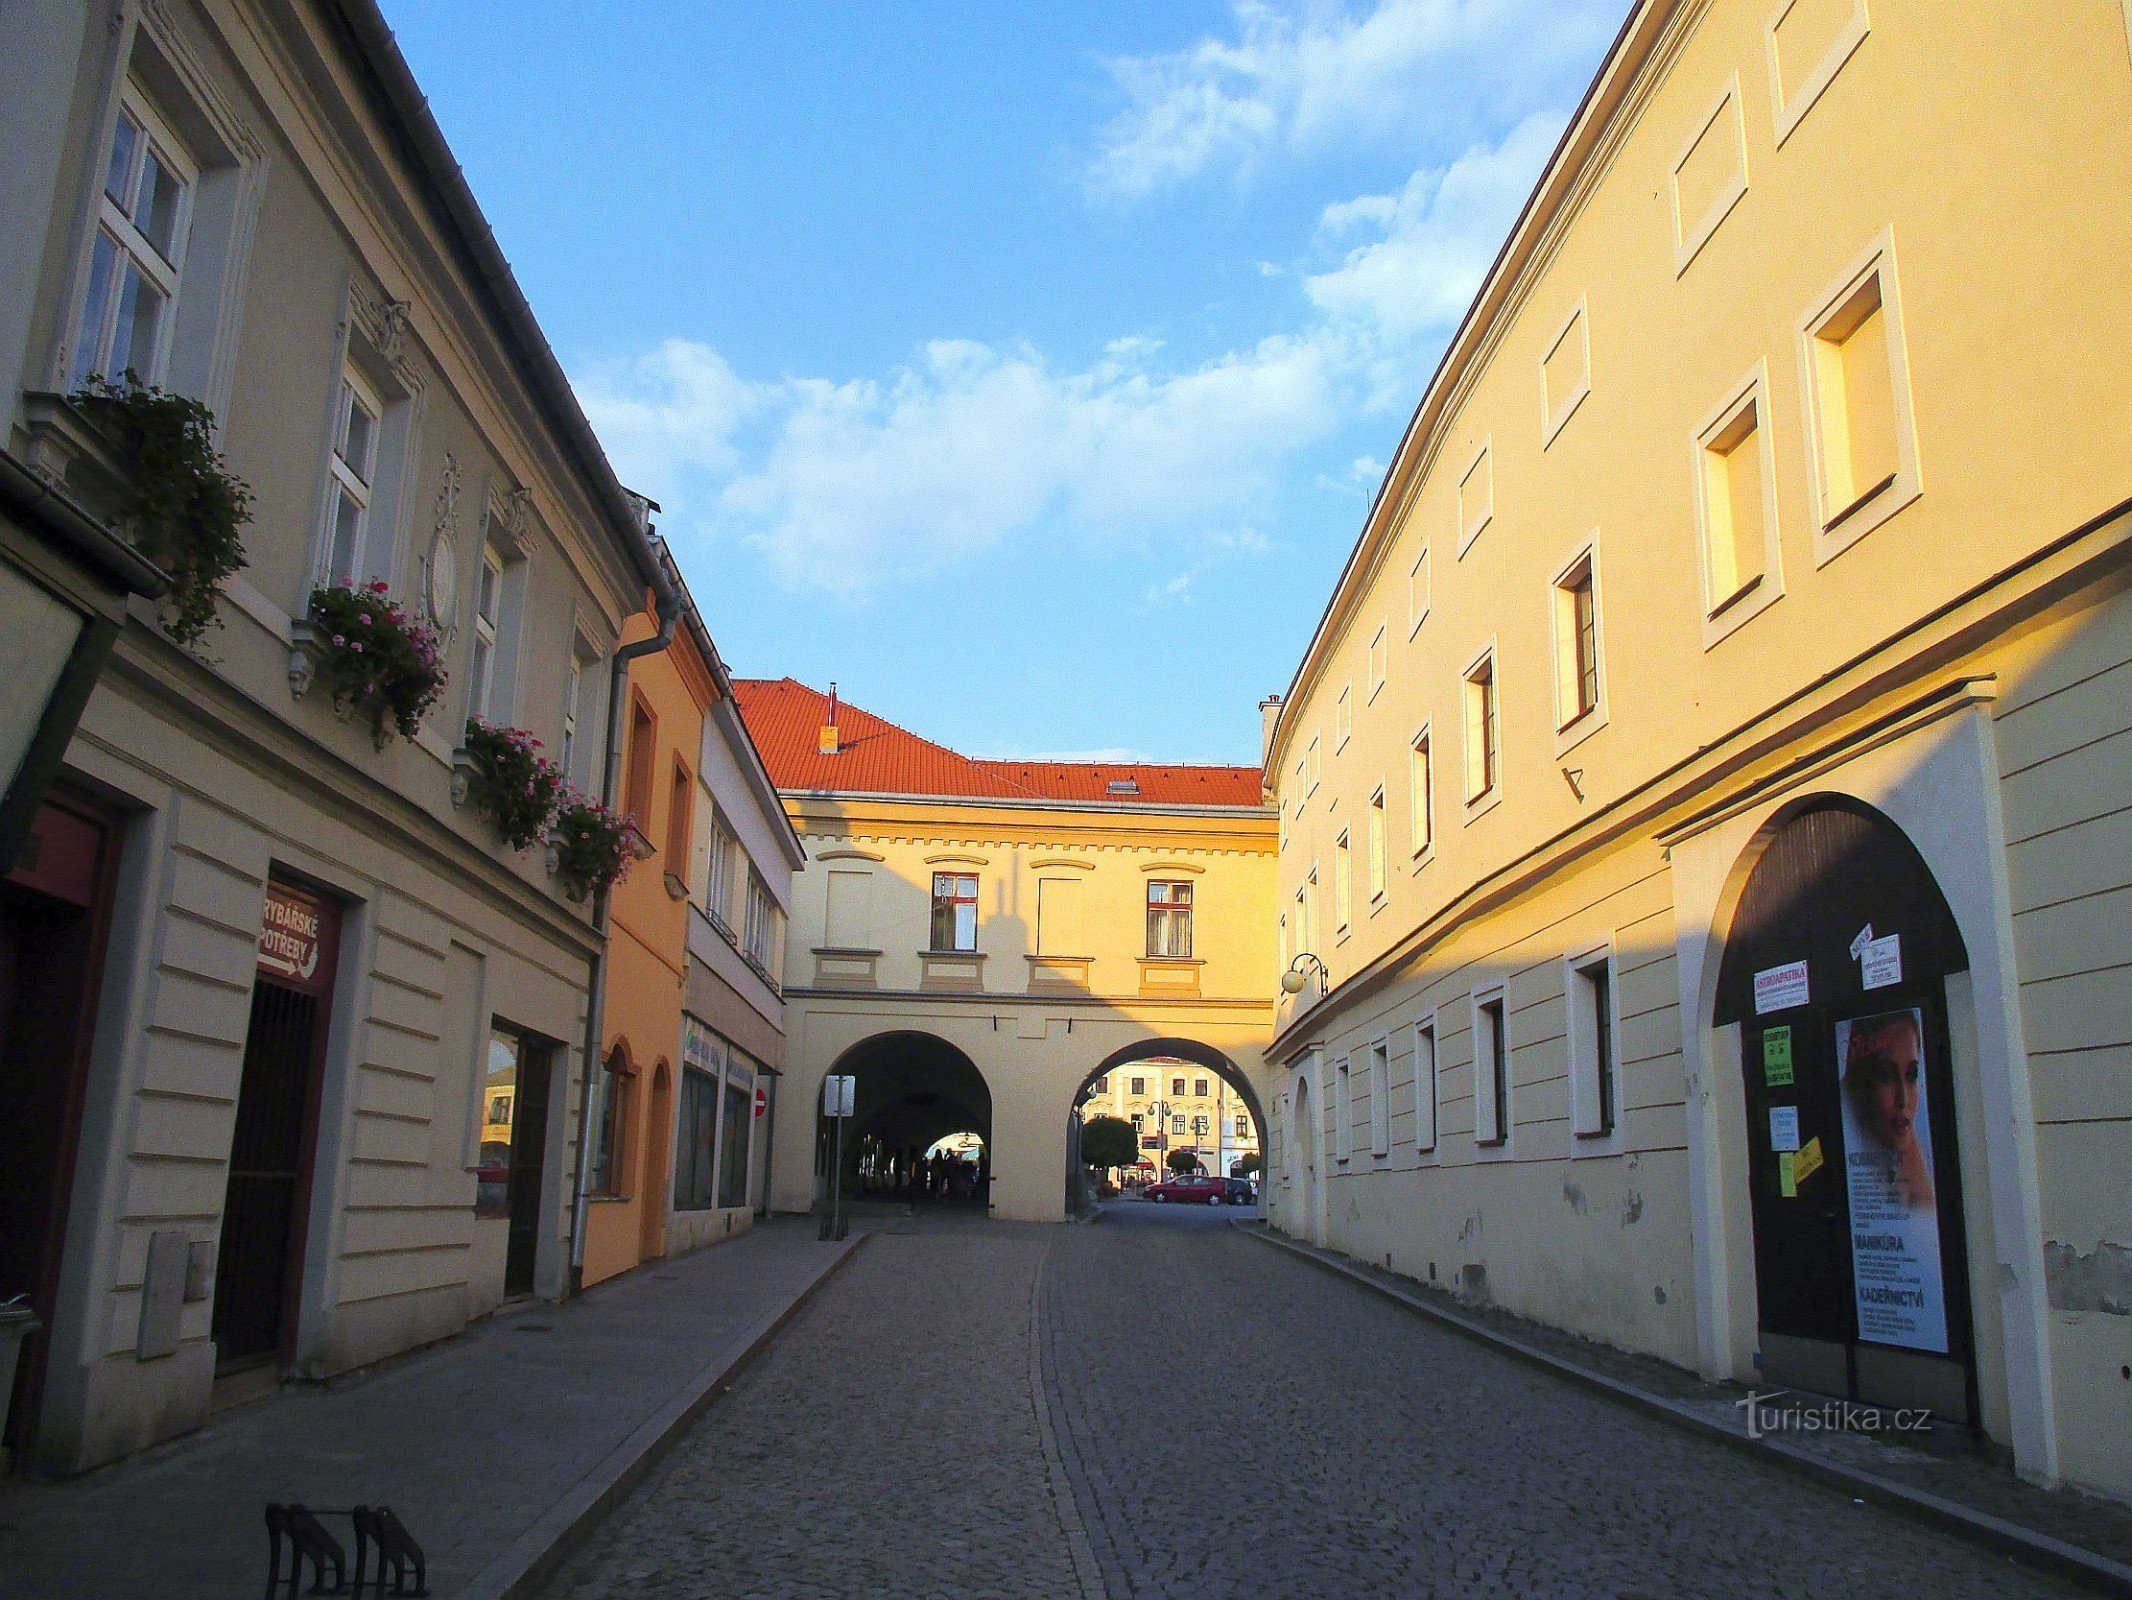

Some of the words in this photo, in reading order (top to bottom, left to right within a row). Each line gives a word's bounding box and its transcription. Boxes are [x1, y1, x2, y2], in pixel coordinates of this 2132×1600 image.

[264, 898, 319, 938] RYBÁŘSKÉ
[259, 926, 308, 961] POTŘEBY
[1860, 1285, 1925, 1308] KADEŘNICTVÍ
